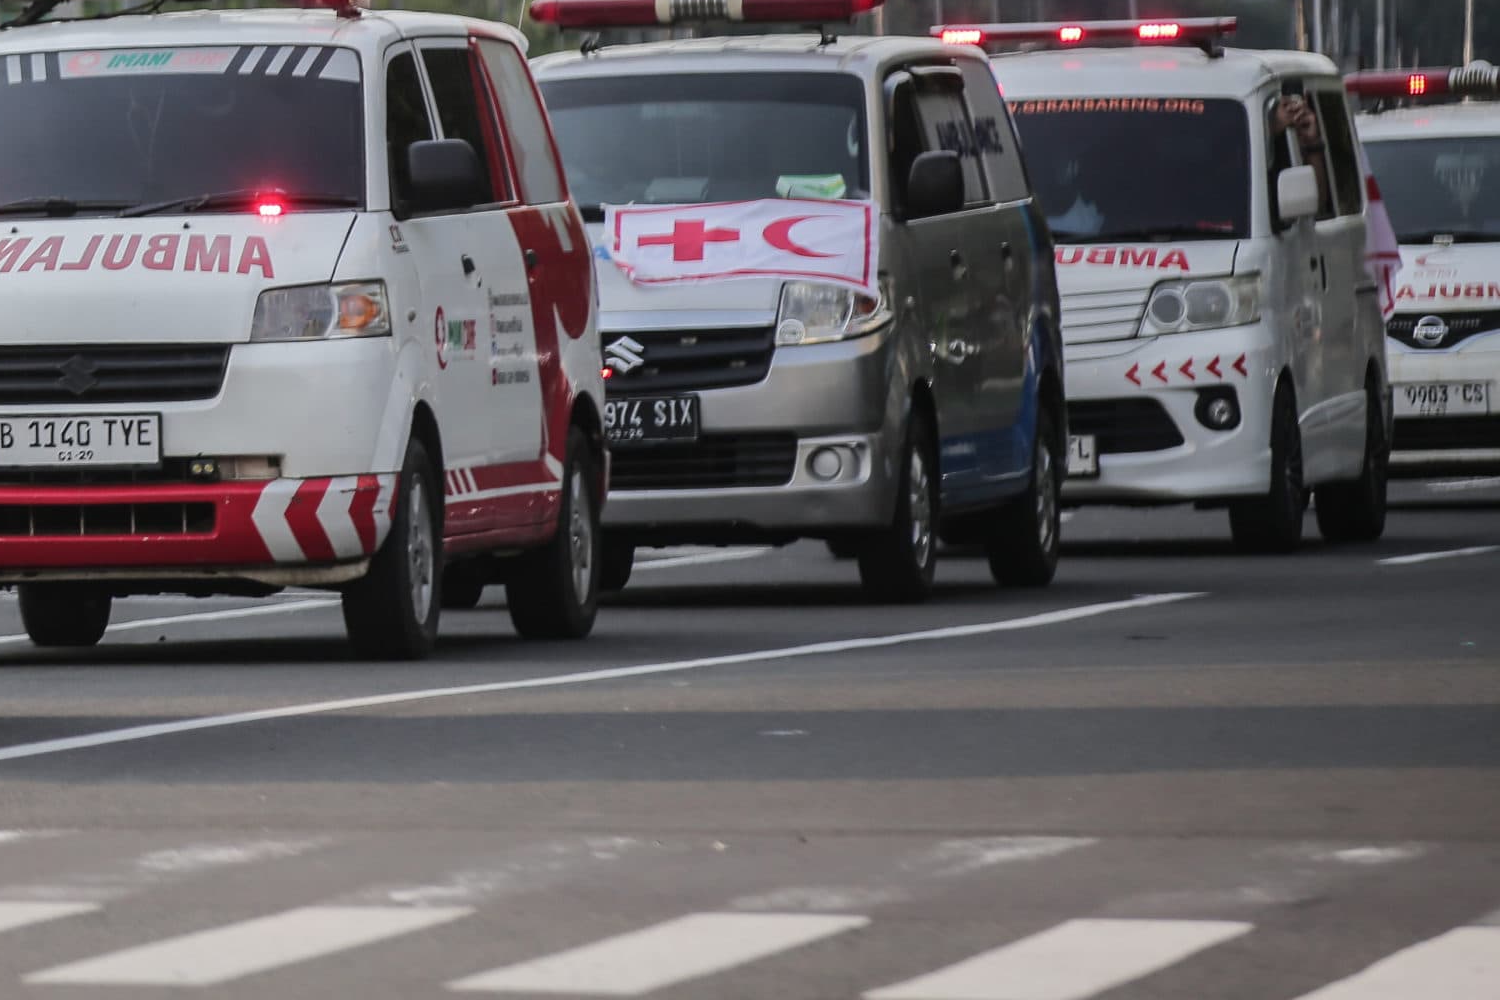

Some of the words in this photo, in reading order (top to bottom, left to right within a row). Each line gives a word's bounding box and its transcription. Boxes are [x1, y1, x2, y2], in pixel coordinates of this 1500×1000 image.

[106, 52, 173, 69] IMANI
[653, 399, 693, 427] SIX
[0, 422, 14, 449] B
[28, 420, 92, 448] 1140
[103, 419, 152, 447] TYE
